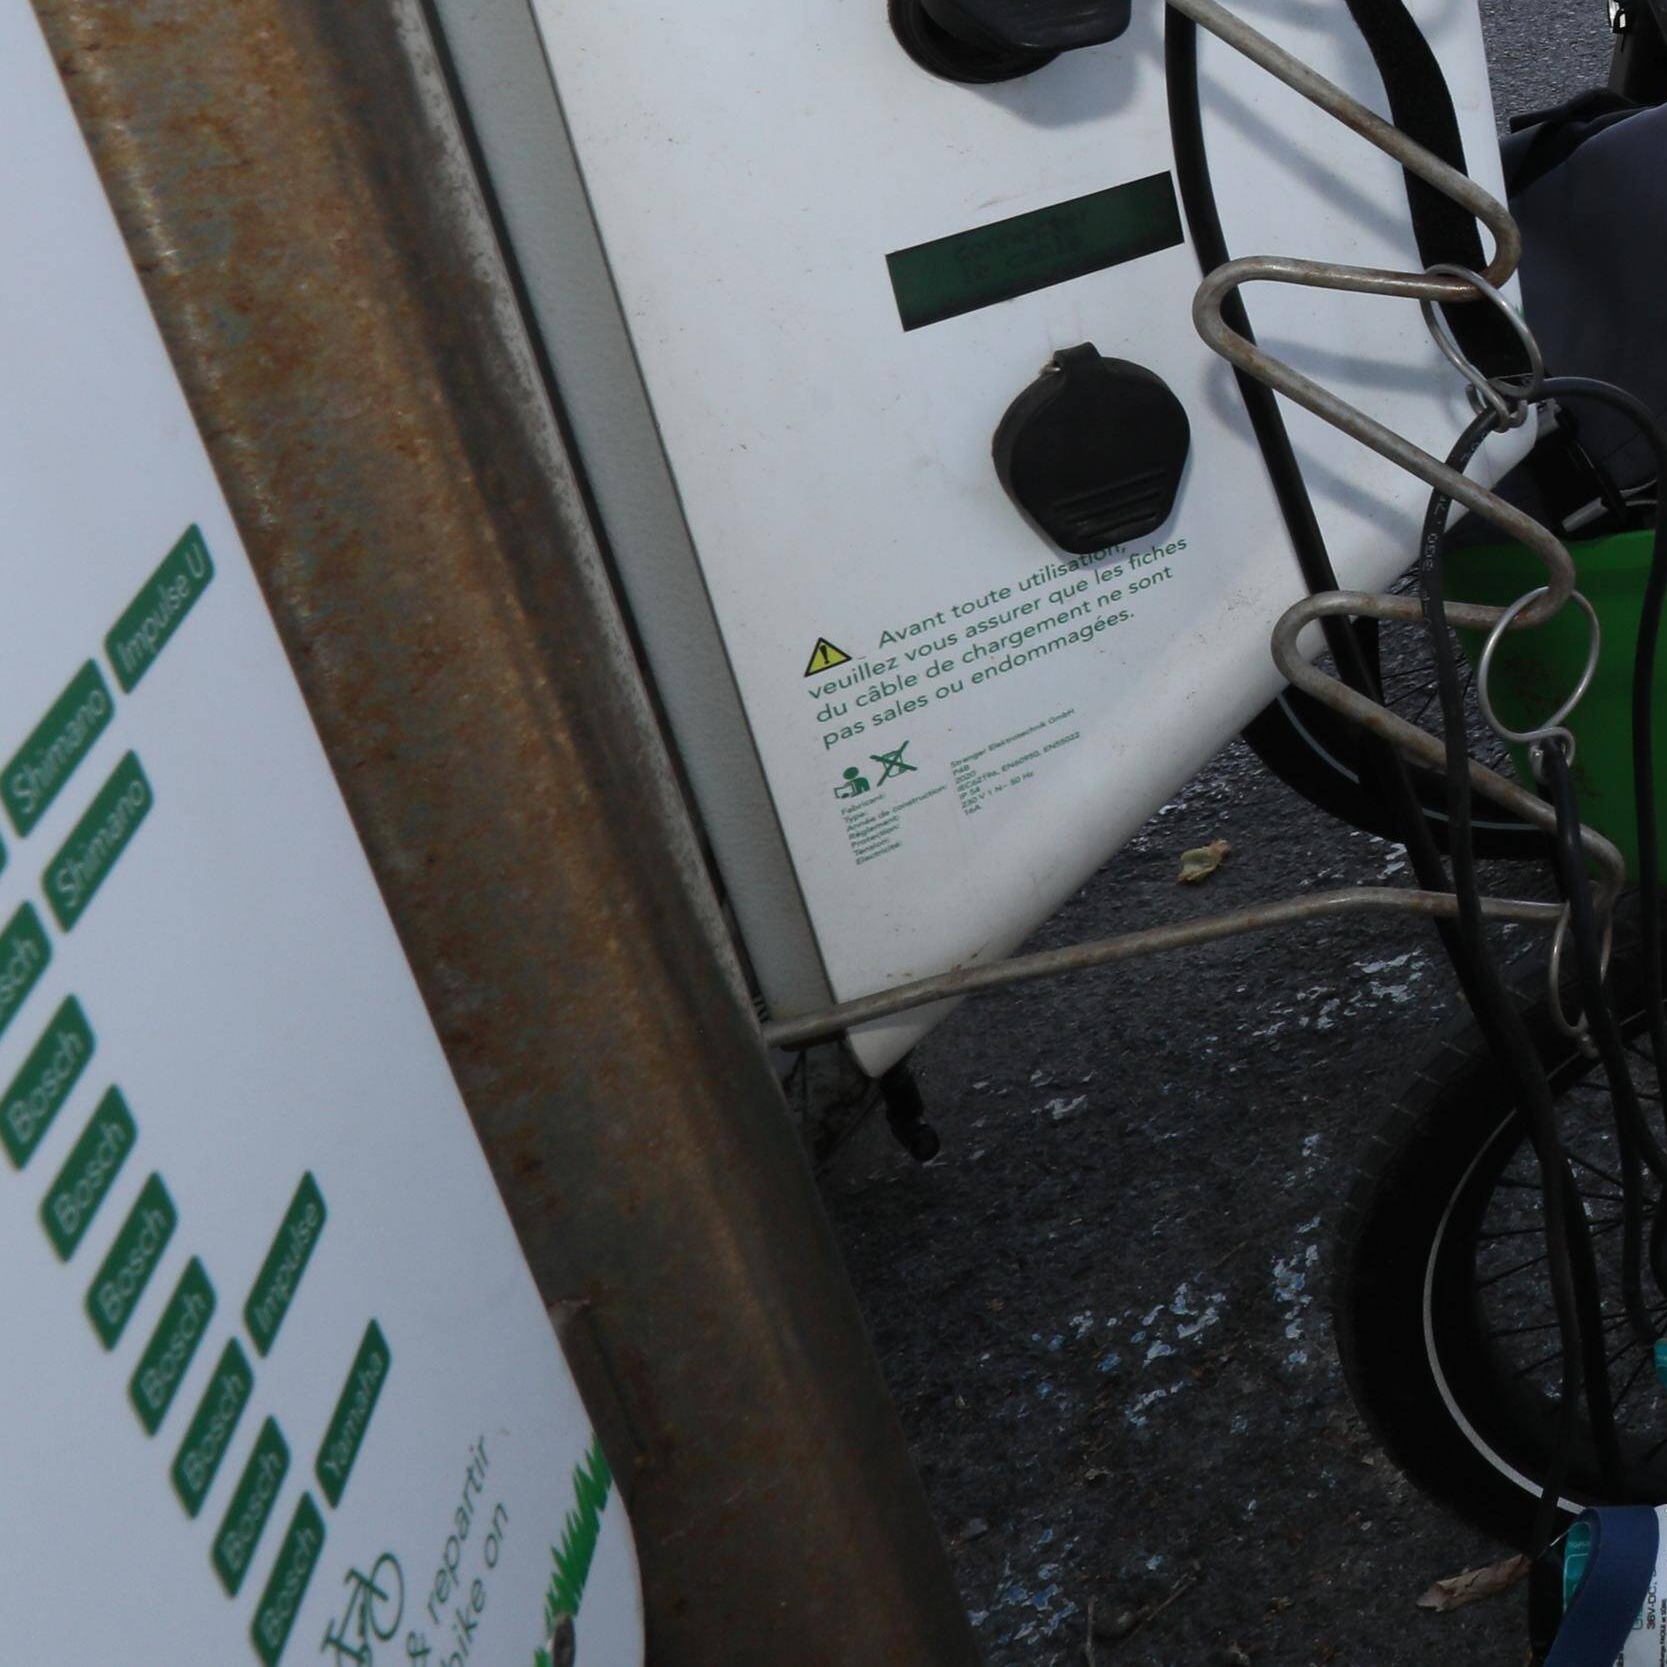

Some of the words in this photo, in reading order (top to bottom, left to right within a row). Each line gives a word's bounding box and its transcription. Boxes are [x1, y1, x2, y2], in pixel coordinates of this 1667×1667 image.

[808, 656, 899, 700] veuillez
[904, 632, 958, 662] vous
[965, 597, 1042, 639] assurer
[1048, 580, 1089, 605] que
[1094, 565, 1124, 585] les
[1129, 538, 1187, 570] fiches
[816, 702, 848, 723] du
[855, 673, 918, 708] câble
[926, 659, 955, 679] de
[962, 601, 1092, 664] chargement
[1097, 589, 1122, 608] ne
[1128, 566, 1174, 595] sont
[822, 720, 865, 750] pas
[872, 693, 929, 726] sales
[935, 680, 964, 701] ou
[971, 608, 1135, 685] endommagées.
[878, 611, 946, 650] Avant
[951, 586, 1012, 619] toute
[11, 688, 106, 815] Shimano
[55, 779, 146, 909] Shimano
[8, 1033, 83, 1144] Bosch
[54, 1120, 125, 1235] Bosch
[98, 1208, 168, 1325] Bosch
[141, 1292, 207, 1410] Bosch
[428, 1433, 489, 1626] repartir
[484, 1502, 508, 1569] on
